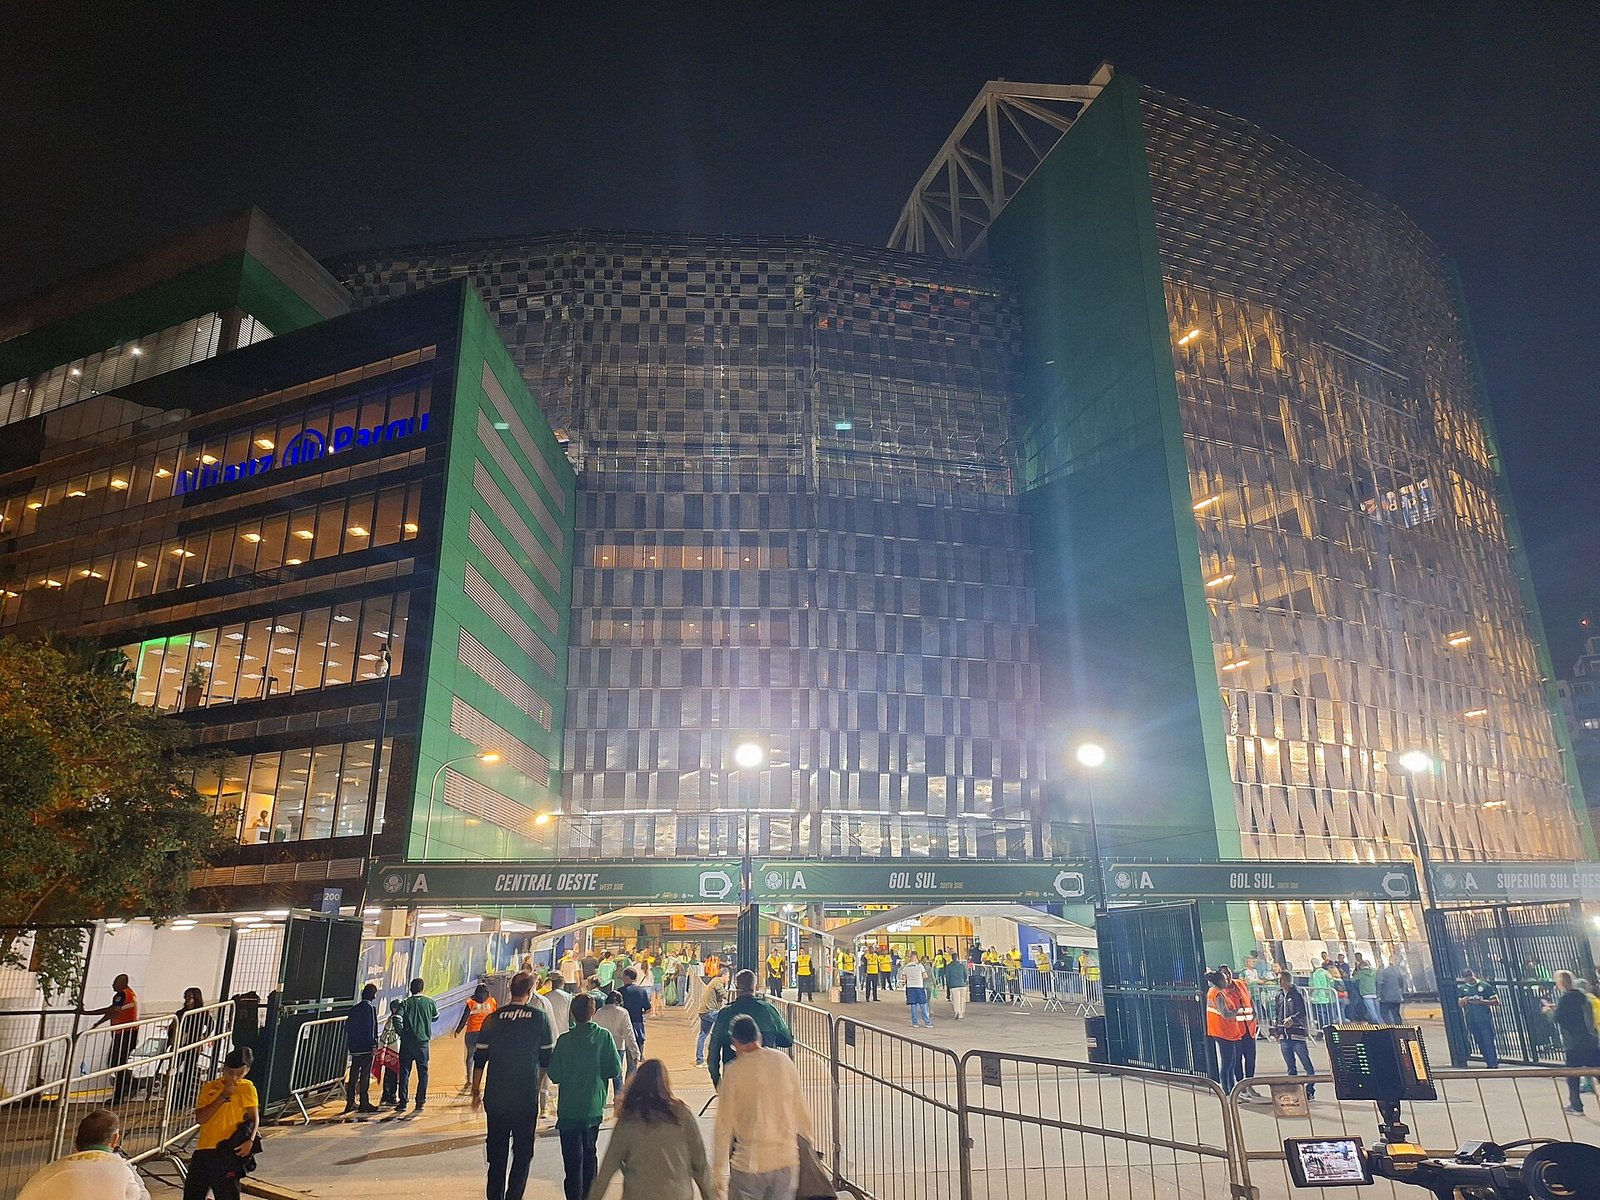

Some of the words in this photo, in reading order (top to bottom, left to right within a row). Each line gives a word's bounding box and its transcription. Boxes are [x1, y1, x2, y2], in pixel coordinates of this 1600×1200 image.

[411, 873, 429, 893] A
[495, 873, 552, 892] CENTRAL
[556, 872, 599, 891] OESTE
[791, 870, 807, 890] A
[888, 872, 911, 889] GOL
[914, 872, 937, 889] SUL
[1140, 871, 1155, 889] A
[1229, 872, 1250, 889] GOL
[1253, 872, 1275, 889] SUL
[1465, 872, 1478, 890] A
[1497, 873, 1547, 889] SUPERIOR
[1550, 873, 1569, 889] SUL
[1573, 873, 1579, 889] E
[324, 893, 340, 901] 200
